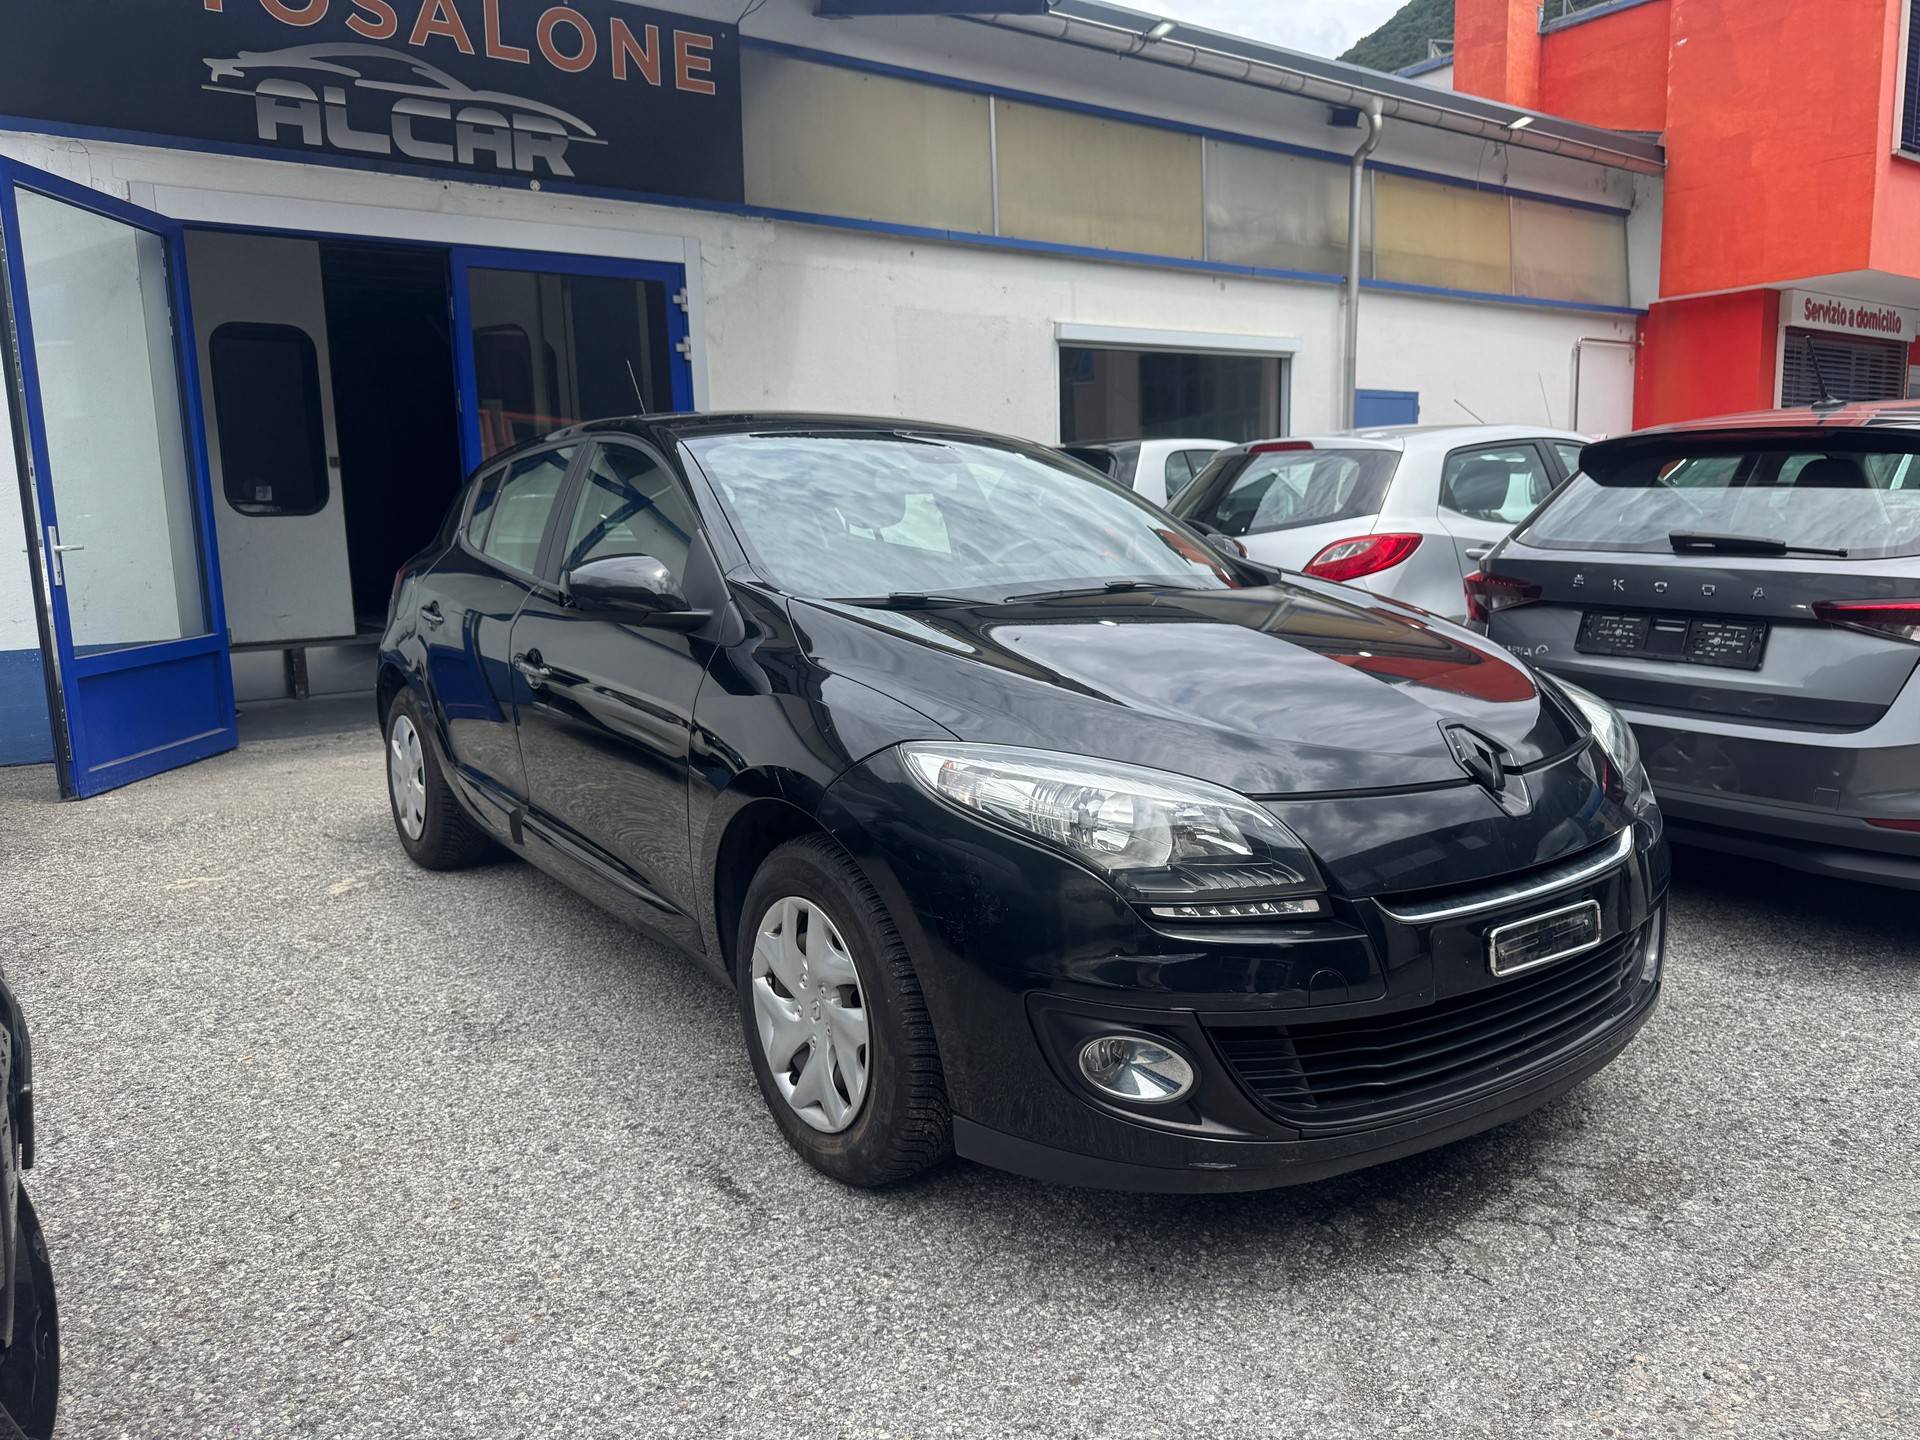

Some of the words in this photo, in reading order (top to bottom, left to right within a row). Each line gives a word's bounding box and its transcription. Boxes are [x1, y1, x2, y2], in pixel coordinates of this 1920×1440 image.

[204, 0, 716, 95] SALONE
[255, 78, 575, 177] ALCAR
[1804, 297, 1847, 326] Servizio
[1848, 308, 1855, 328] a
[1856, 306, 1902, 334] domicilio
